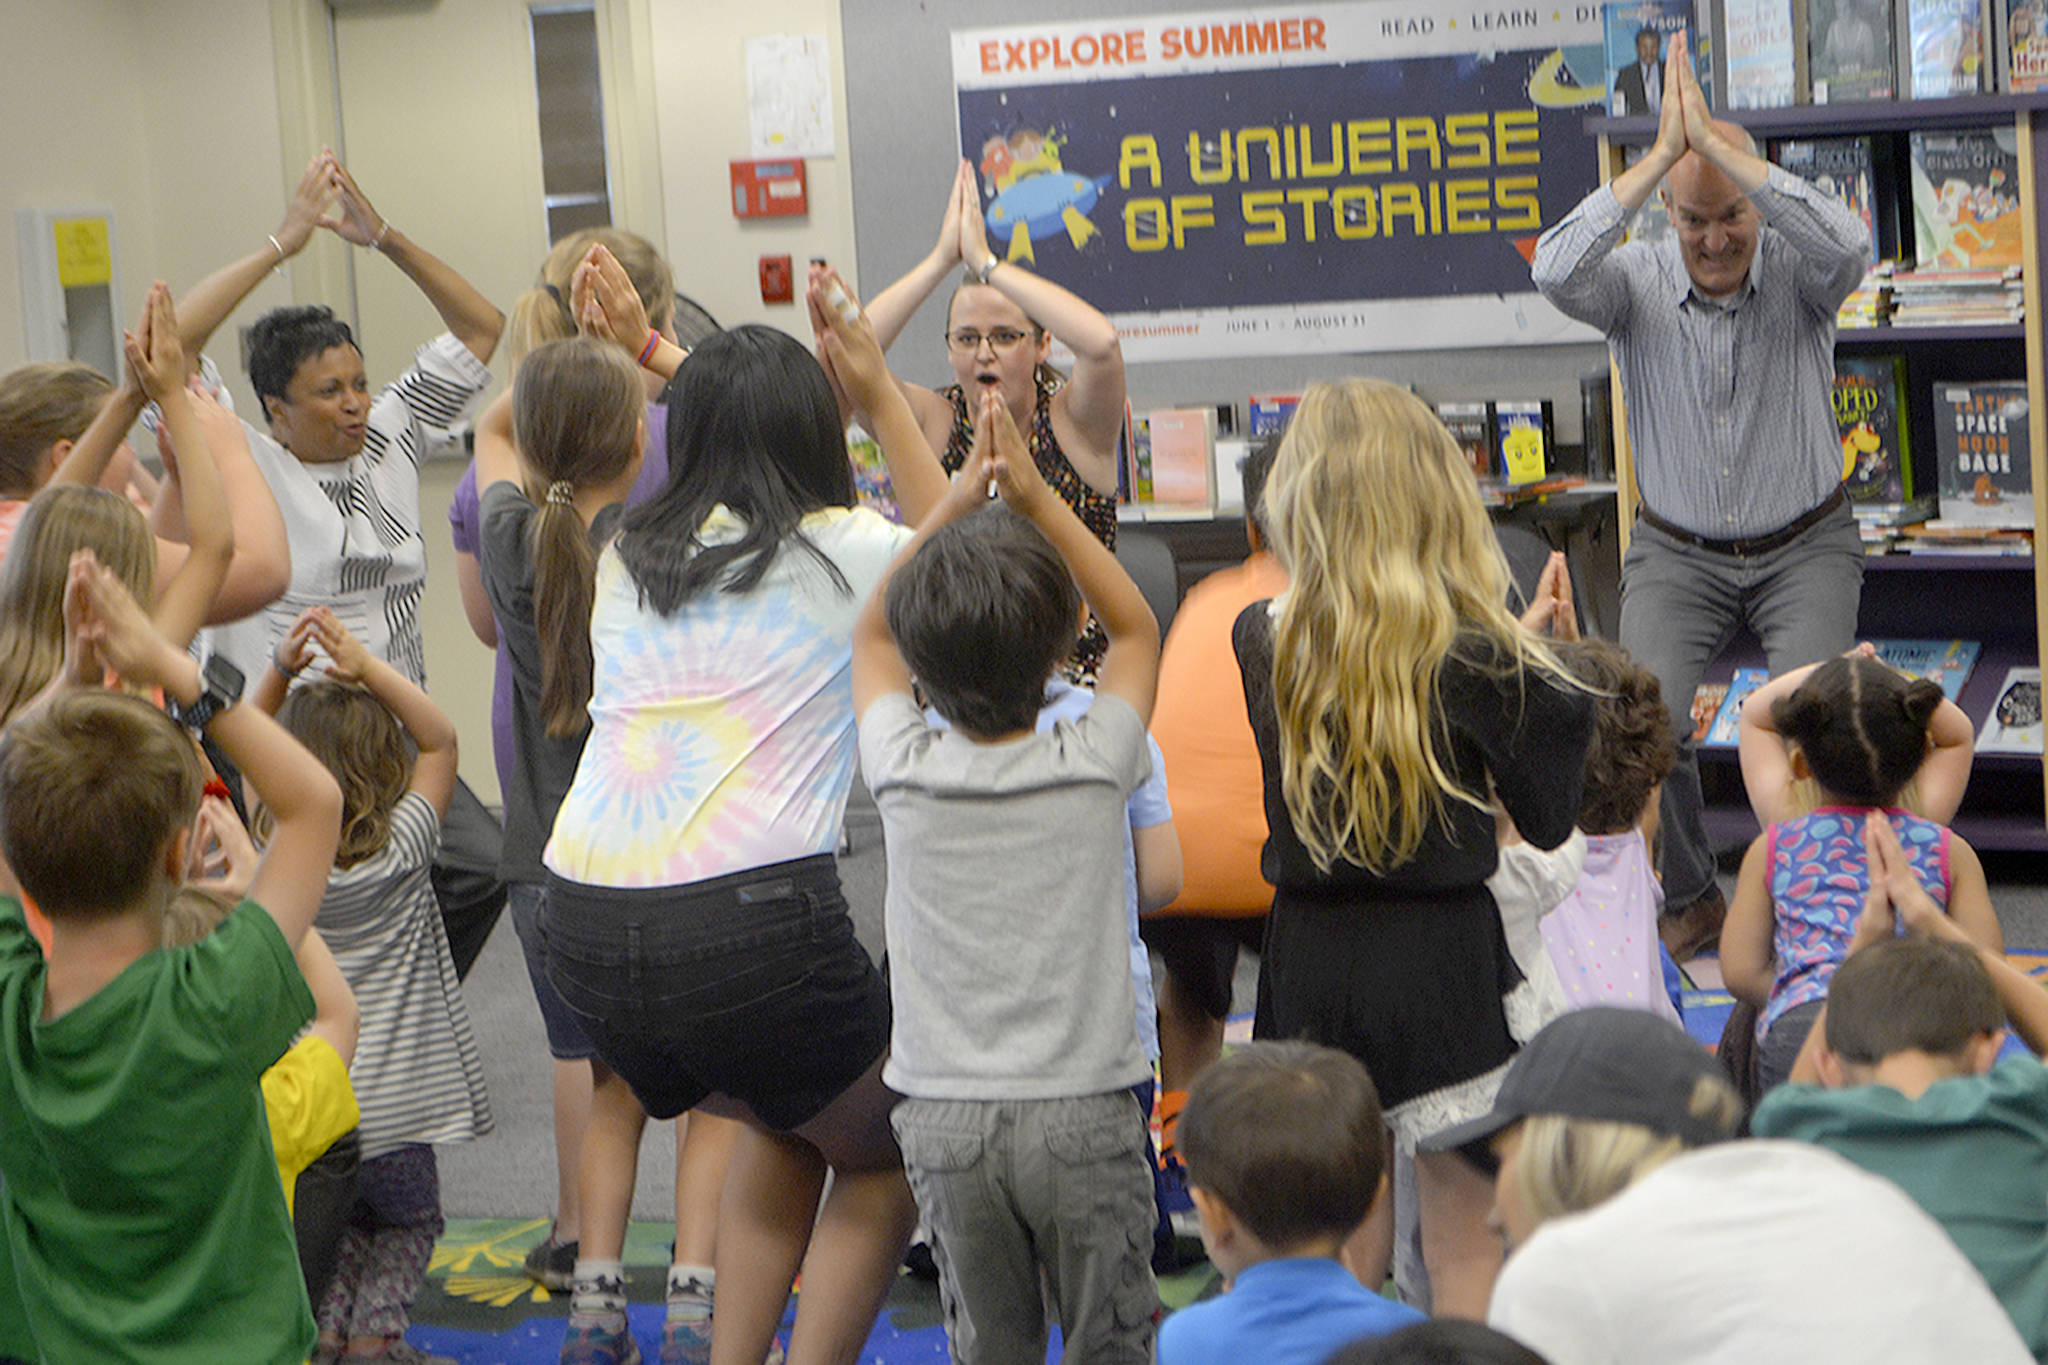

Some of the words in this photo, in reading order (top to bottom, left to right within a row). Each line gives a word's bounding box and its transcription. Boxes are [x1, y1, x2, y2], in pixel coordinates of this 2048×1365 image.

[1380, 18, 1434, 37] READ
[1471, 10, 1538, 31] LEARN
[1575, 5, 1603, 23] DI
[979, 30, 1147, 74] EXPLORE
[1160, 17, 1327, 60] SUMMER
[1740, 25, 1788, 51] GIRLS
[1118, 134, 1163, 189] A
[1187, 110, 1541, 184] UNIVERSE
[1123, 194, 1215, 252] OF
[1241, 175, 1541, 246] STORIES
[1114, 323, 1200, 339] oresummer
[1226, 319, 1257, 334] JUNE
[1293, 314, 1347, 331] AUGUST
[1956, 413, 2008, 434] SPACE
[1957, 435, 2009, 453] MOON
[1958, 453, 2012, 474] BASE
